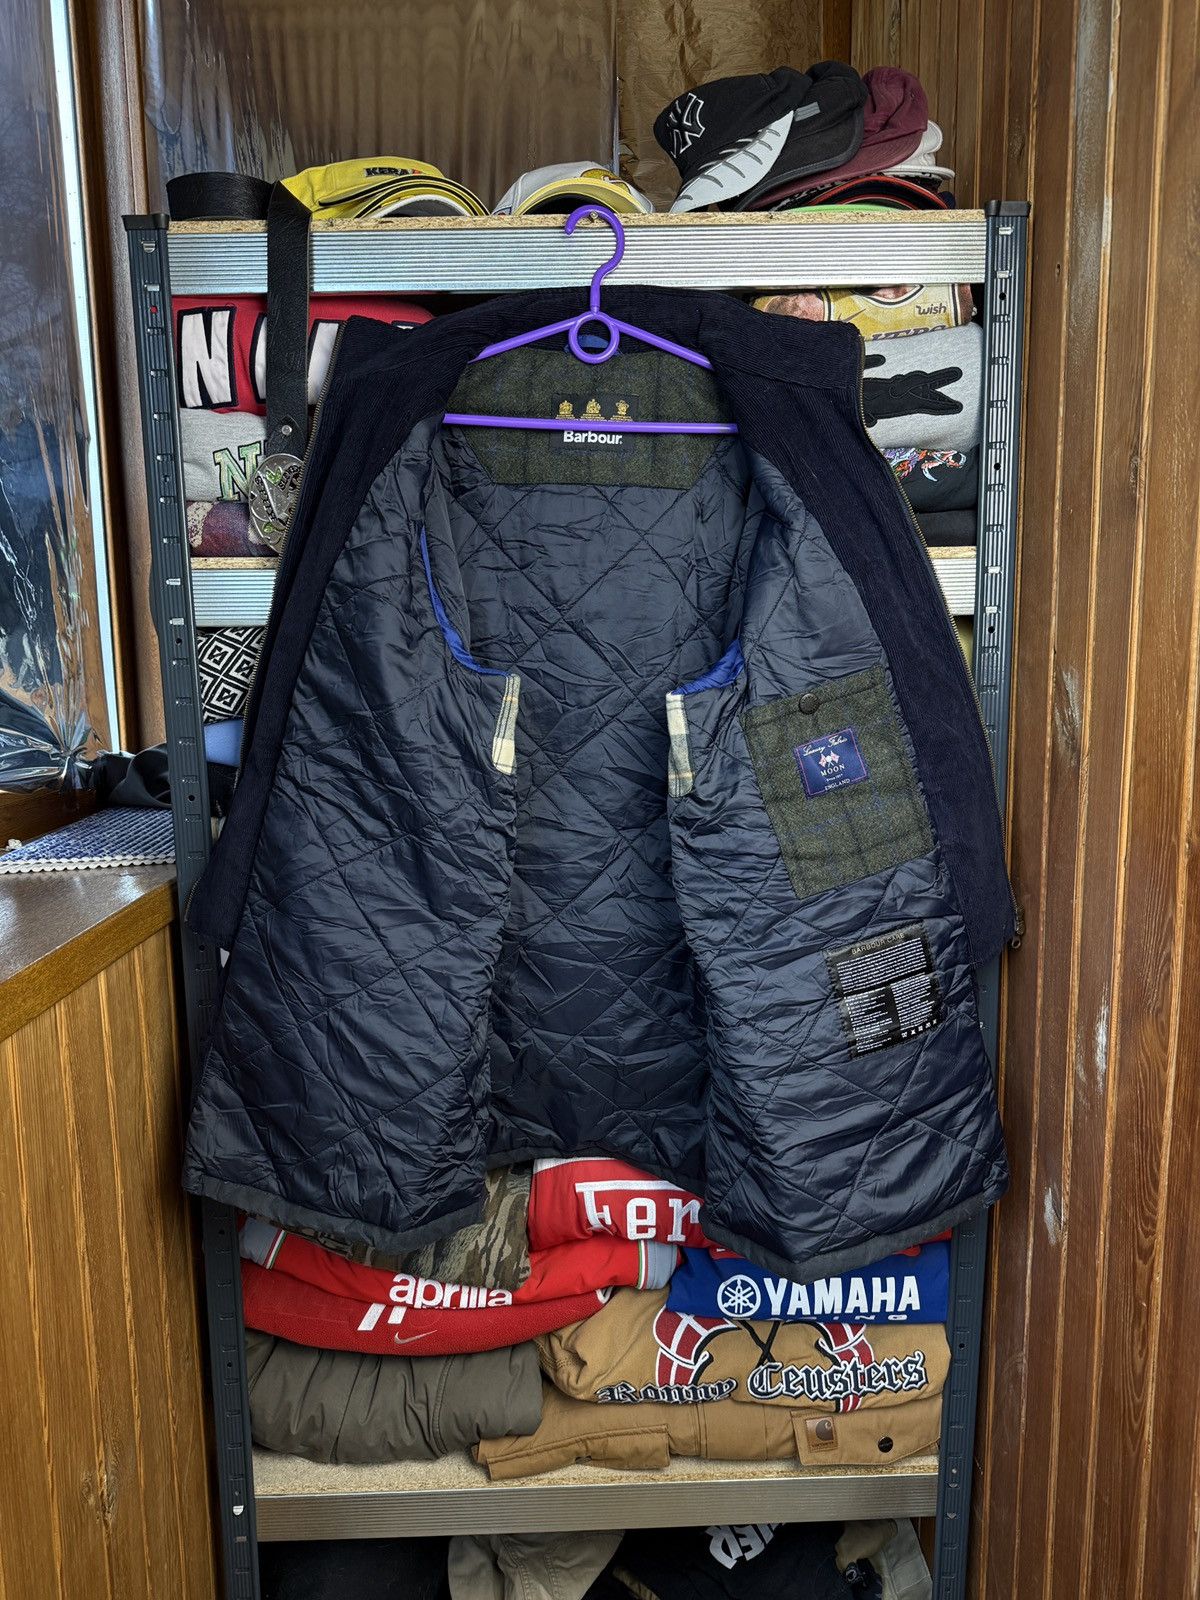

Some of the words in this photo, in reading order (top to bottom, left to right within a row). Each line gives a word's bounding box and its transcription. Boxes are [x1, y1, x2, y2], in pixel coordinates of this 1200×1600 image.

[915, 302, 947, 316] wish
[820, 763, 845, 777] MOON
[824, 778, 851, 791] ENGLAND
[851, 938, 886, 955] BARBOUR
[763, 1275, 921, 1316] YAMAHA
[747, 1350, 929, 1401] Ceusters
